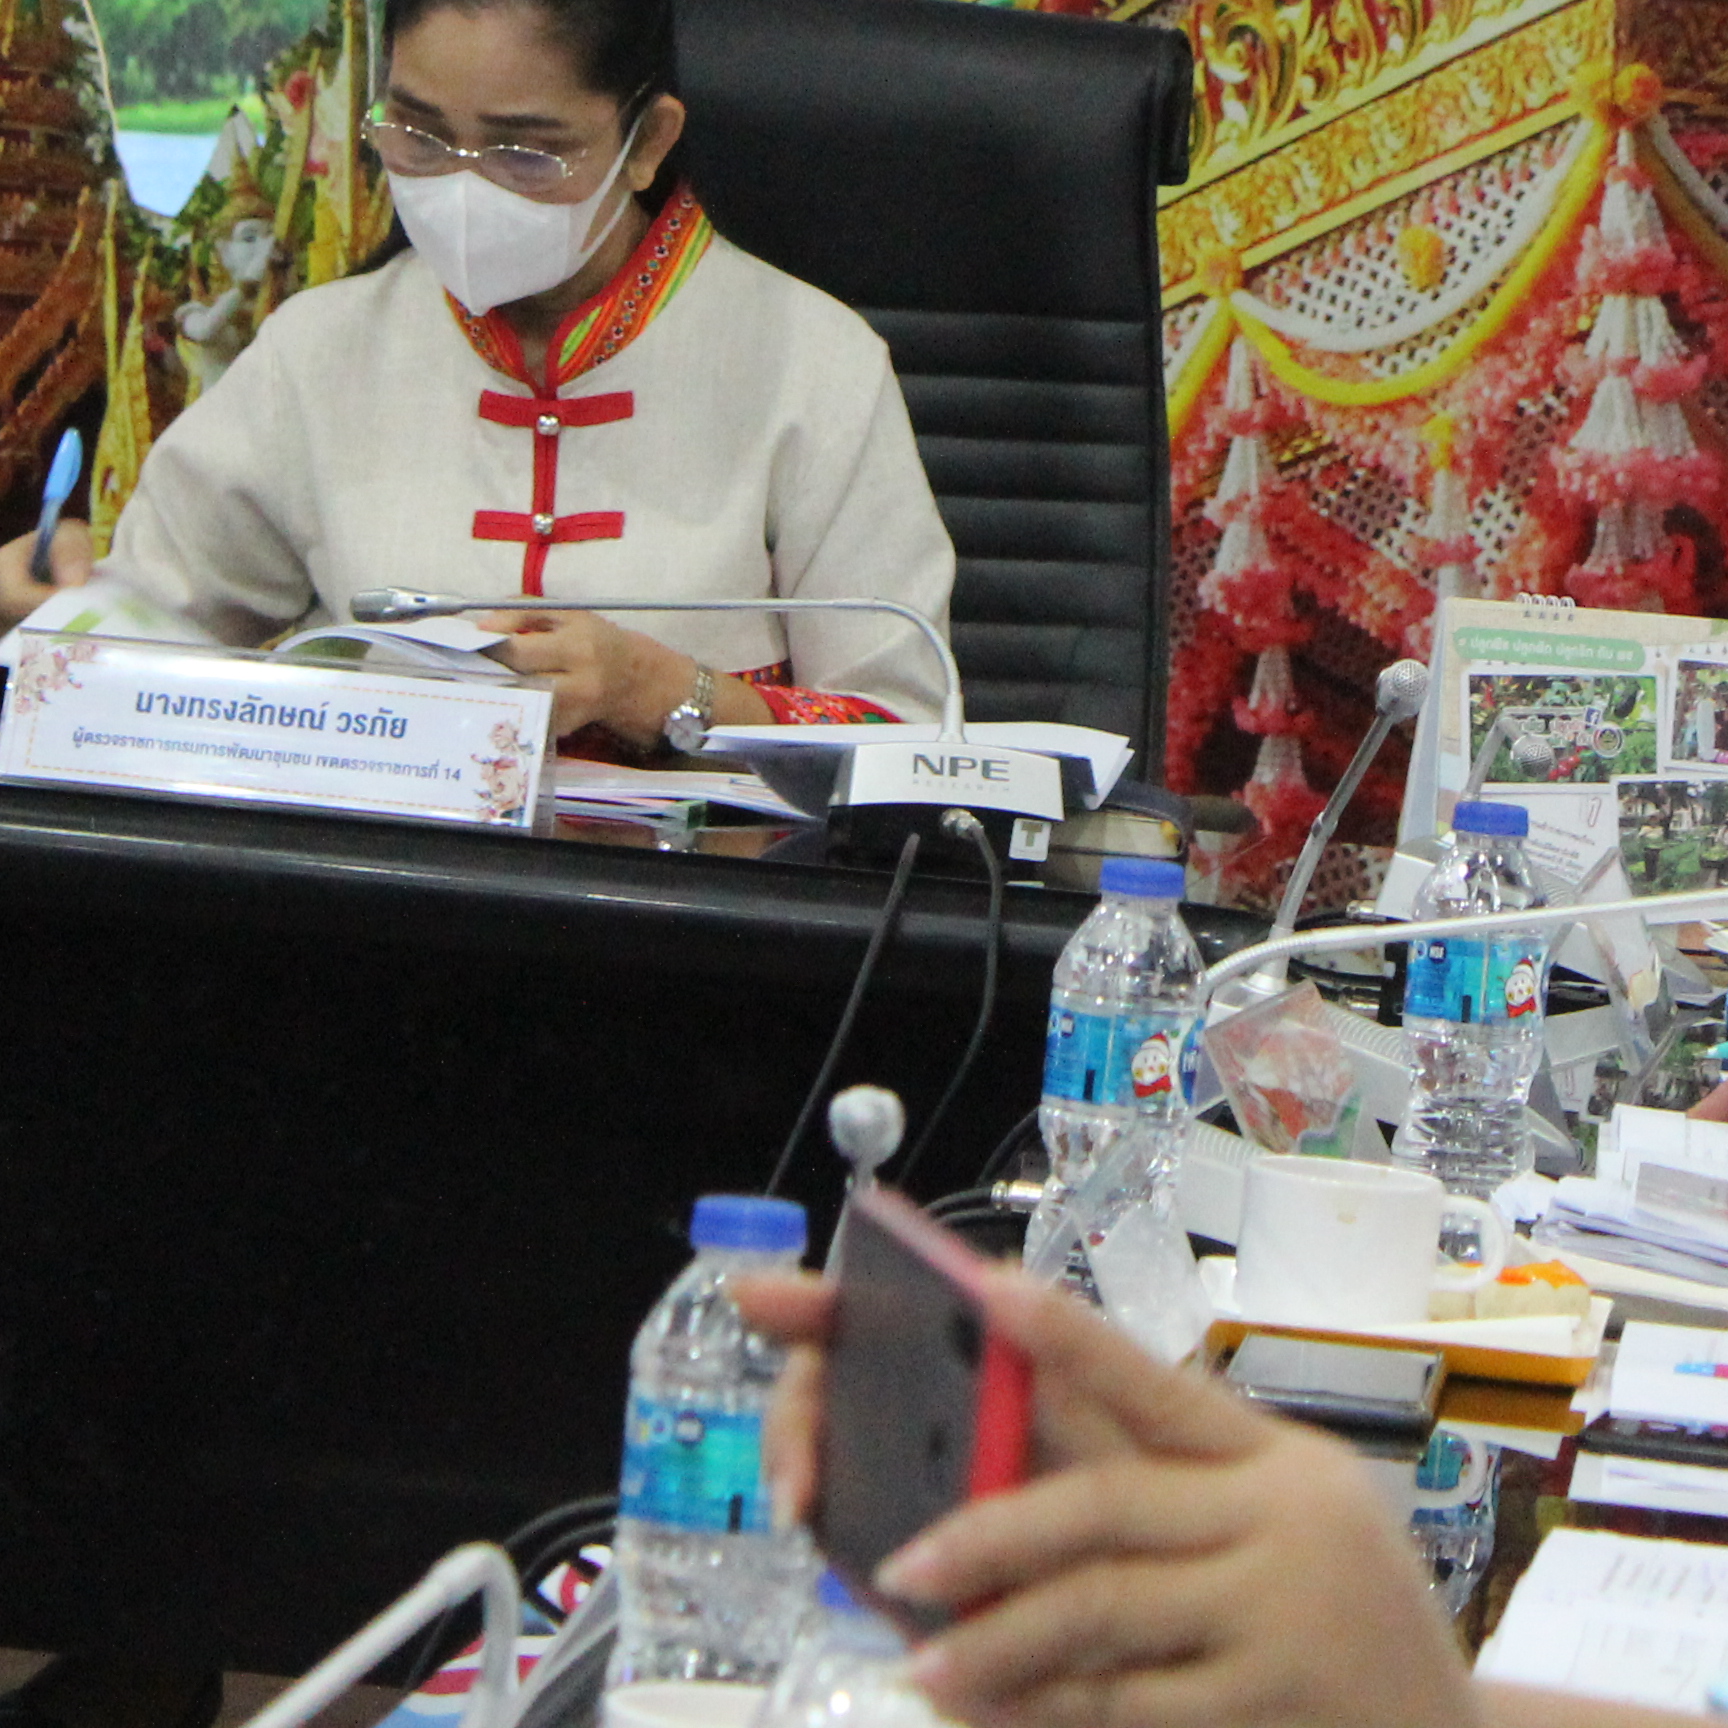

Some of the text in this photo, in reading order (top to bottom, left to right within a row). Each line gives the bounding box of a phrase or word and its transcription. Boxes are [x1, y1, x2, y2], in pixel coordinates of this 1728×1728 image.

[135, 690, 408, 739] นางทรงลักษณ์ วรภัย
[444, 767, 462, 781] 14
[913, 753, 1010, 782] NPE
